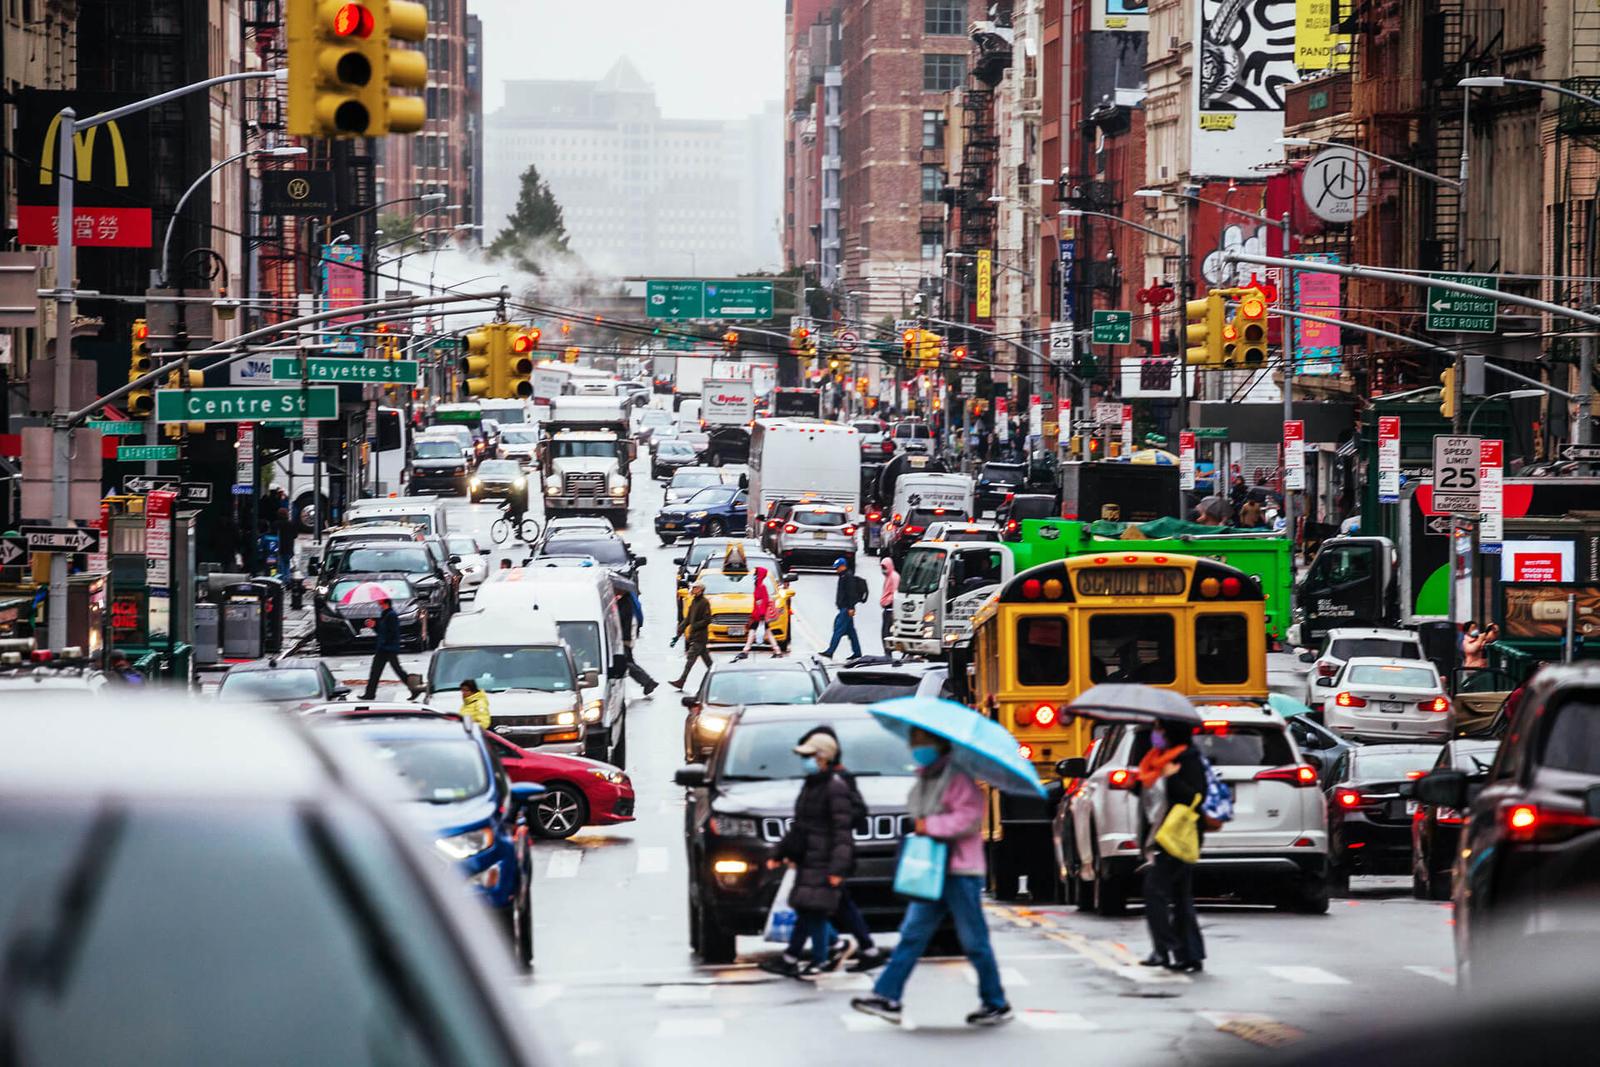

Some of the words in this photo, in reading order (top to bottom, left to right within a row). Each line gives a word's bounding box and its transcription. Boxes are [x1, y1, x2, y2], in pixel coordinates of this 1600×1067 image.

[1453, 301, 1494, 313] DISTRICT
[1433, 317, 1456, 327] BEST
[1459, 318, 1490, 329] ROUTE
[1053, 337, 1070, 348] 25
[289, 363, 376, 379] Lfayette
[382, 365, 401, 378] St
[187, 397, 272, 414] Centre
[280, 395, 306, 413] St
[718, 394, 745, 404] Ryder
[1447, 439, 1469, 447] CITY
[1443, 448, 1472, 456] SPEED
[1446, 457, 1470, 465] LIMIT
[1439, 467, 1477, 488] 25
[31, 534, 55, 545] ONE
[64, 535, 88, 545] WAY
